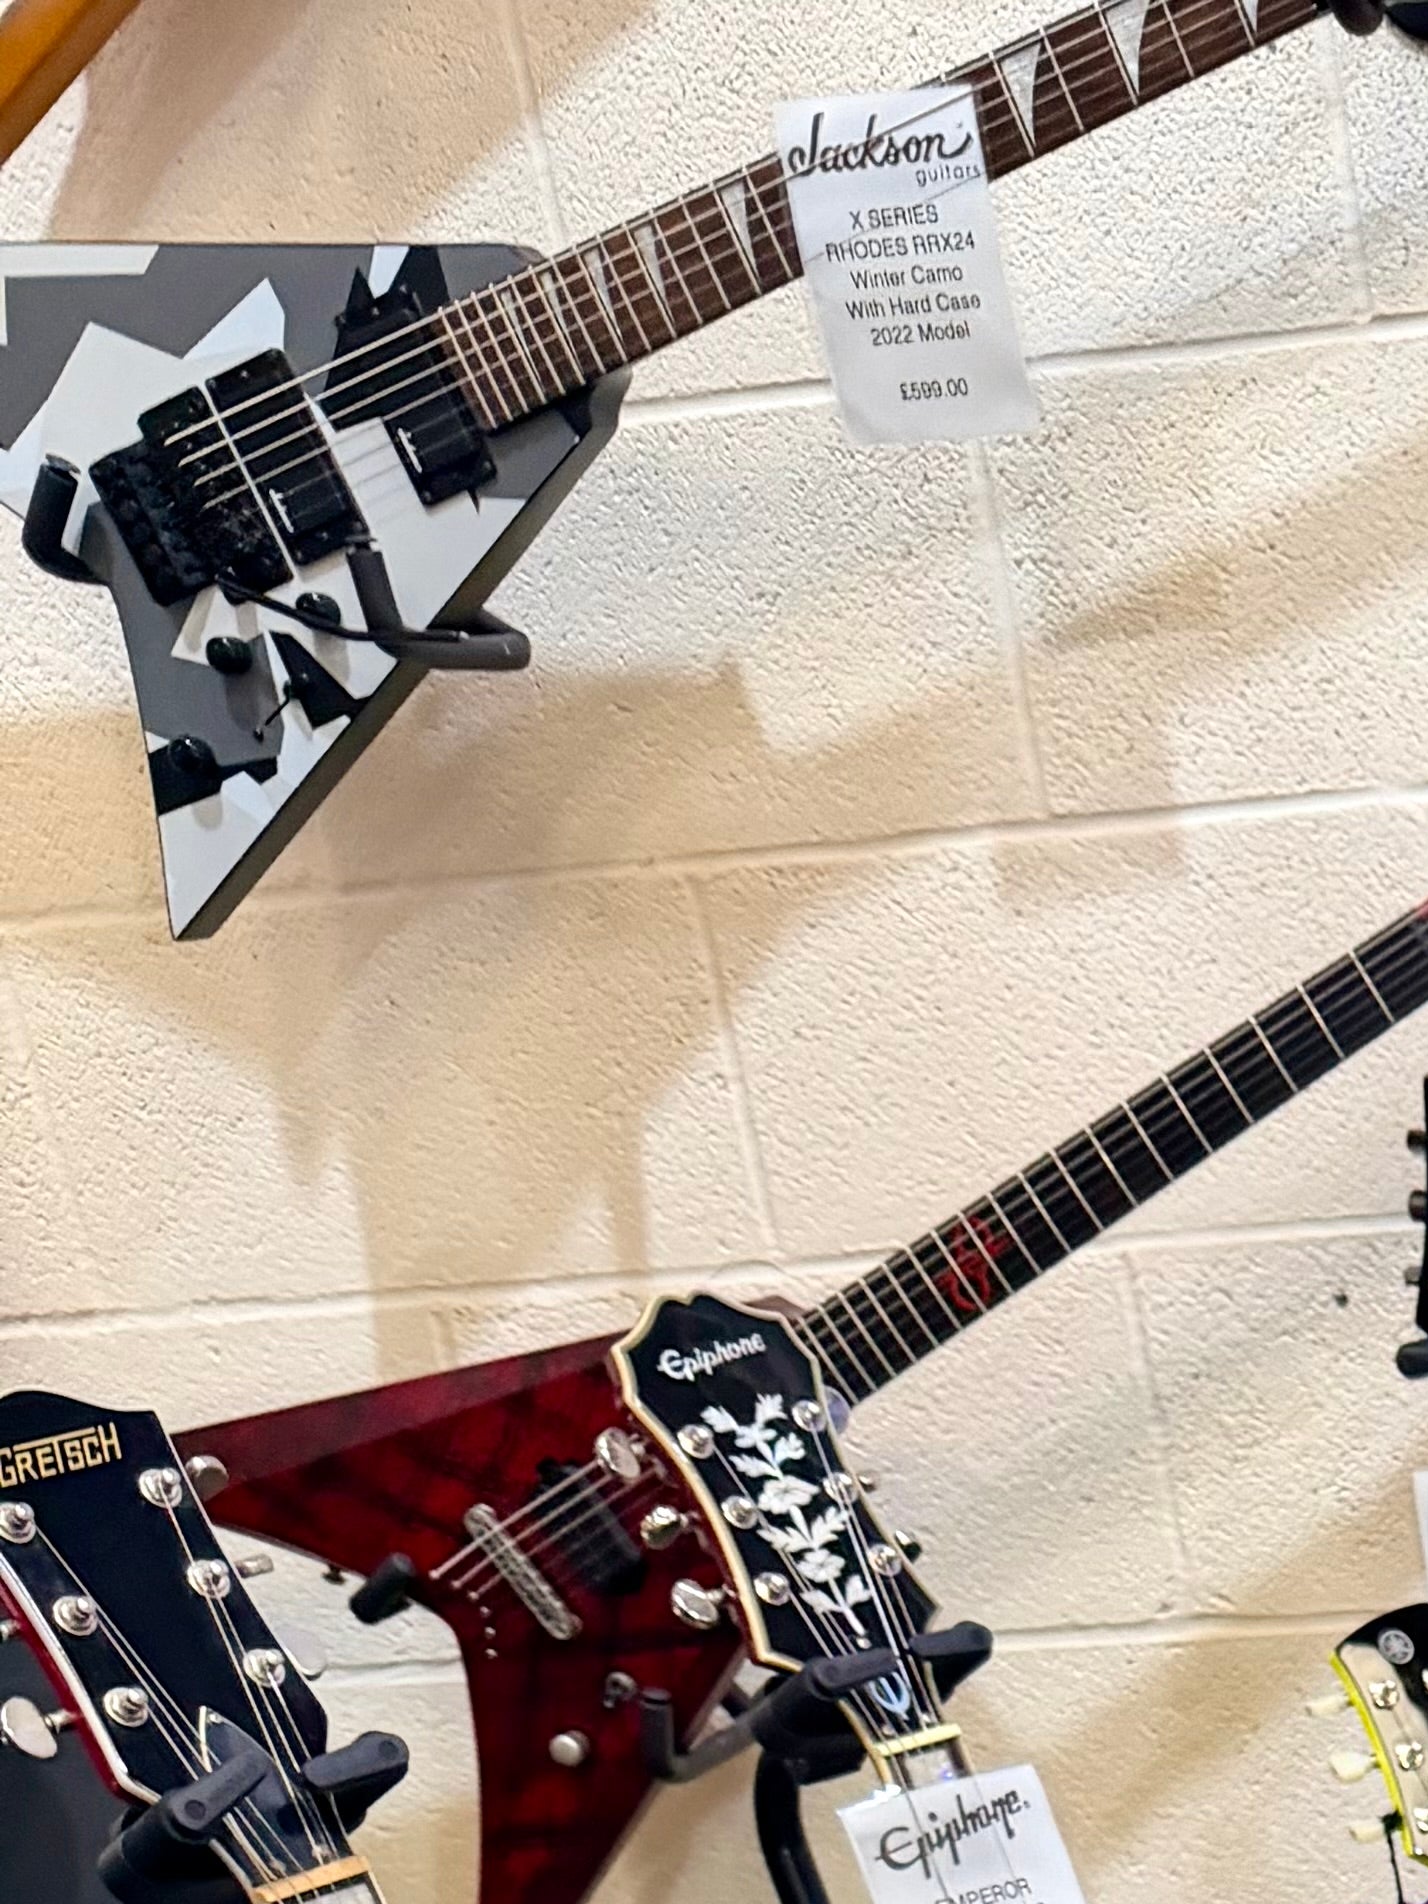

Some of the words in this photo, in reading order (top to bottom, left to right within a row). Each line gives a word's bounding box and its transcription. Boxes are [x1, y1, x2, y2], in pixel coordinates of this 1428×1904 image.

[787, 112, 974, 177] Jackson
[916, 164, 981, 187] guitars
[849, 211, 864, 231] X
[869, 204, 939, 229] SERIES
[825, 236, 907, 262] RHODES
[913, 231, 975, 255] RRX24
[851, 268, 905, 290] Winter
[912, 264, 963, 285] Camo
[845, 299, 885, 320] With
[891, 296, 932, 316] Hard
[936, 293, 981, 312] Case
[871, 325, 912, 346] 2022
[918, 321, 971, 343] Model
[900, 378, 969, 401] £599.00
[657, 1332, 767, 1382] Epiphone
[0, 1422, 122, 1488] GRETSCH
[875, 1789, 1023, 1878] Epiphone
